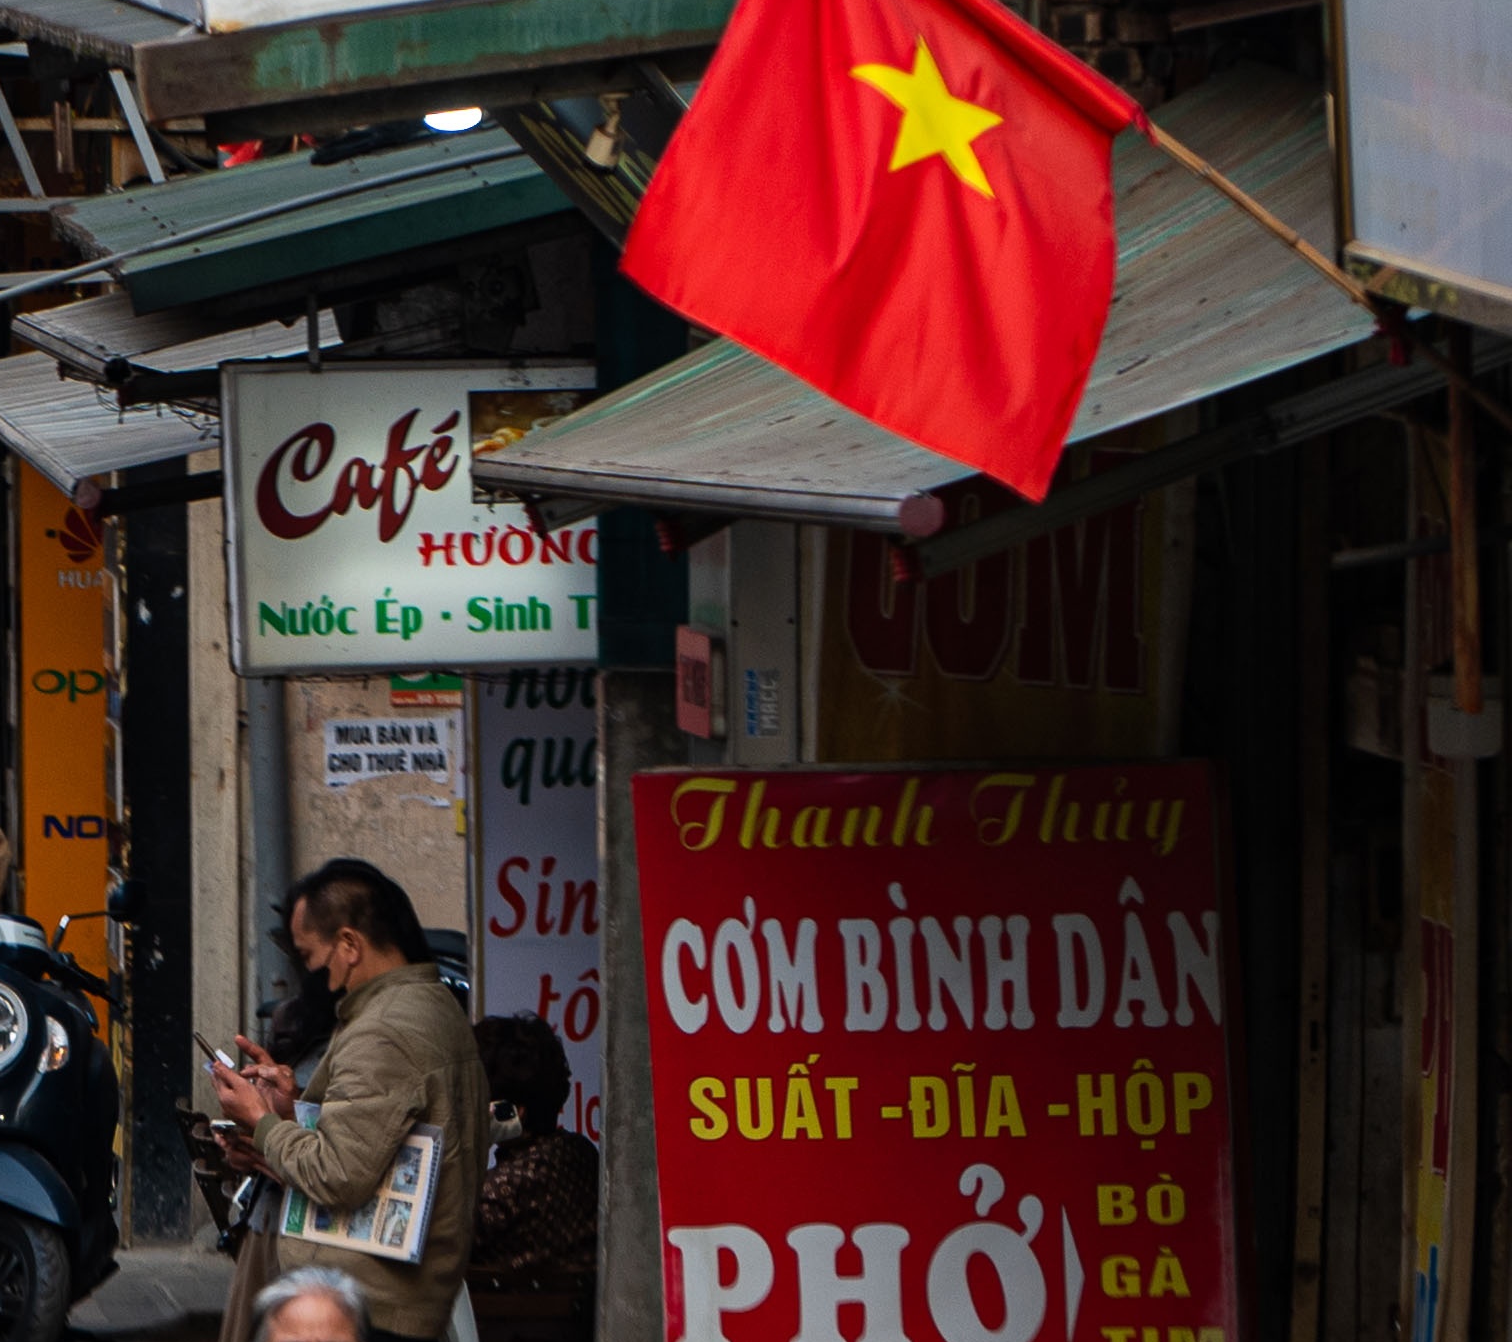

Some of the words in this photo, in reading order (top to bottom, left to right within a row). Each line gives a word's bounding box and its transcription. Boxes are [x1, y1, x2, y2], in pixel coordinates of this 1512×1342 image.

[256, 409, 462, 543] Café
[258, 595, 358, 637] Nước
[374, 587, 423, 642] Ép
[466, 595, 552, 632] Sinh
[327, 752, 363, 774] CHO
[364, 748, 408, 773] THUÊ
[411, 747, 448, 773] NHÀ
[333, 724, 374, 746] MUA
[375, 721, 413, 746] BÁN
[416, 721, 440, 745] VÀ
[668, 774, 939, 852] Thanh
[968, 772, 1188, 855] Thủy
[661, 894, 826, 1035] CƠM
[836, 881, 1036, 1033] BÌNH
[1051, 875, 1223, 1029] DÂN
[688, 1054, 859, 1142] SUẤT
[1097, 1173, 1187, 1228] BÒ
[1101, 1247, 1192, 1300] GÀ
